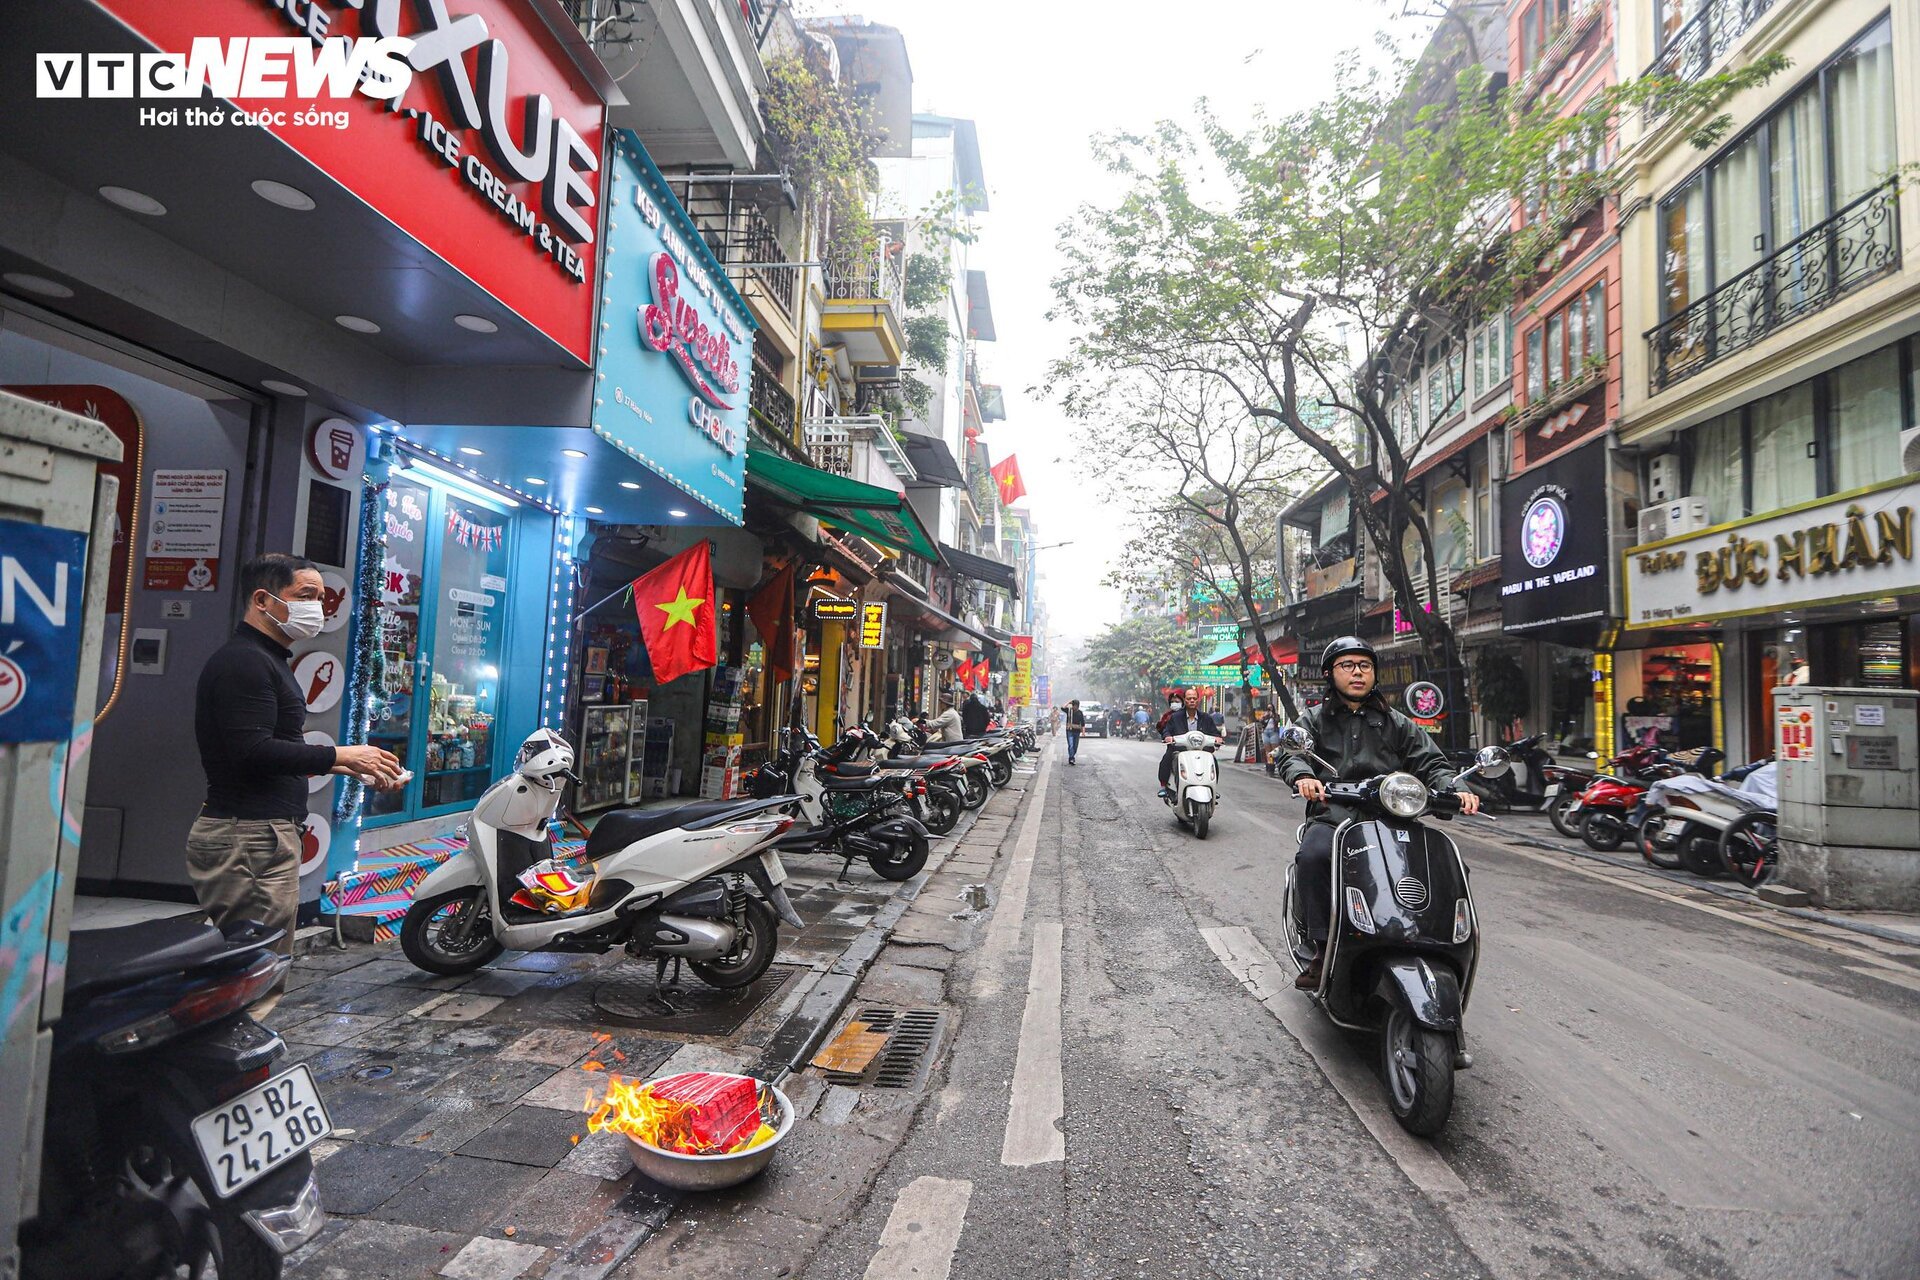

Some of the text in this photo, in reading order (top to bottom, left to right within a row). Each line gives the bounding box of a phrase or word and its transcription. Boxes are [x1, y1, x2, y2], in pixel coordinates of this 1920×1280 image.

[422, 111, 586, 284] ICE CREAM & TEA
[688, 396, 738, 457] CHOICE
[1502, 565, 1597, 596] MABU IN THE VAPELAND
[1696, 533, 1770, 595] ĐỨC
[1774, 504, 1915, 582] NHÂN
[476, 621, 491, 632] SUN
[214, 1079, 302, 1147] 29-B2
[218, 1106, 323, 1188] 242.86
